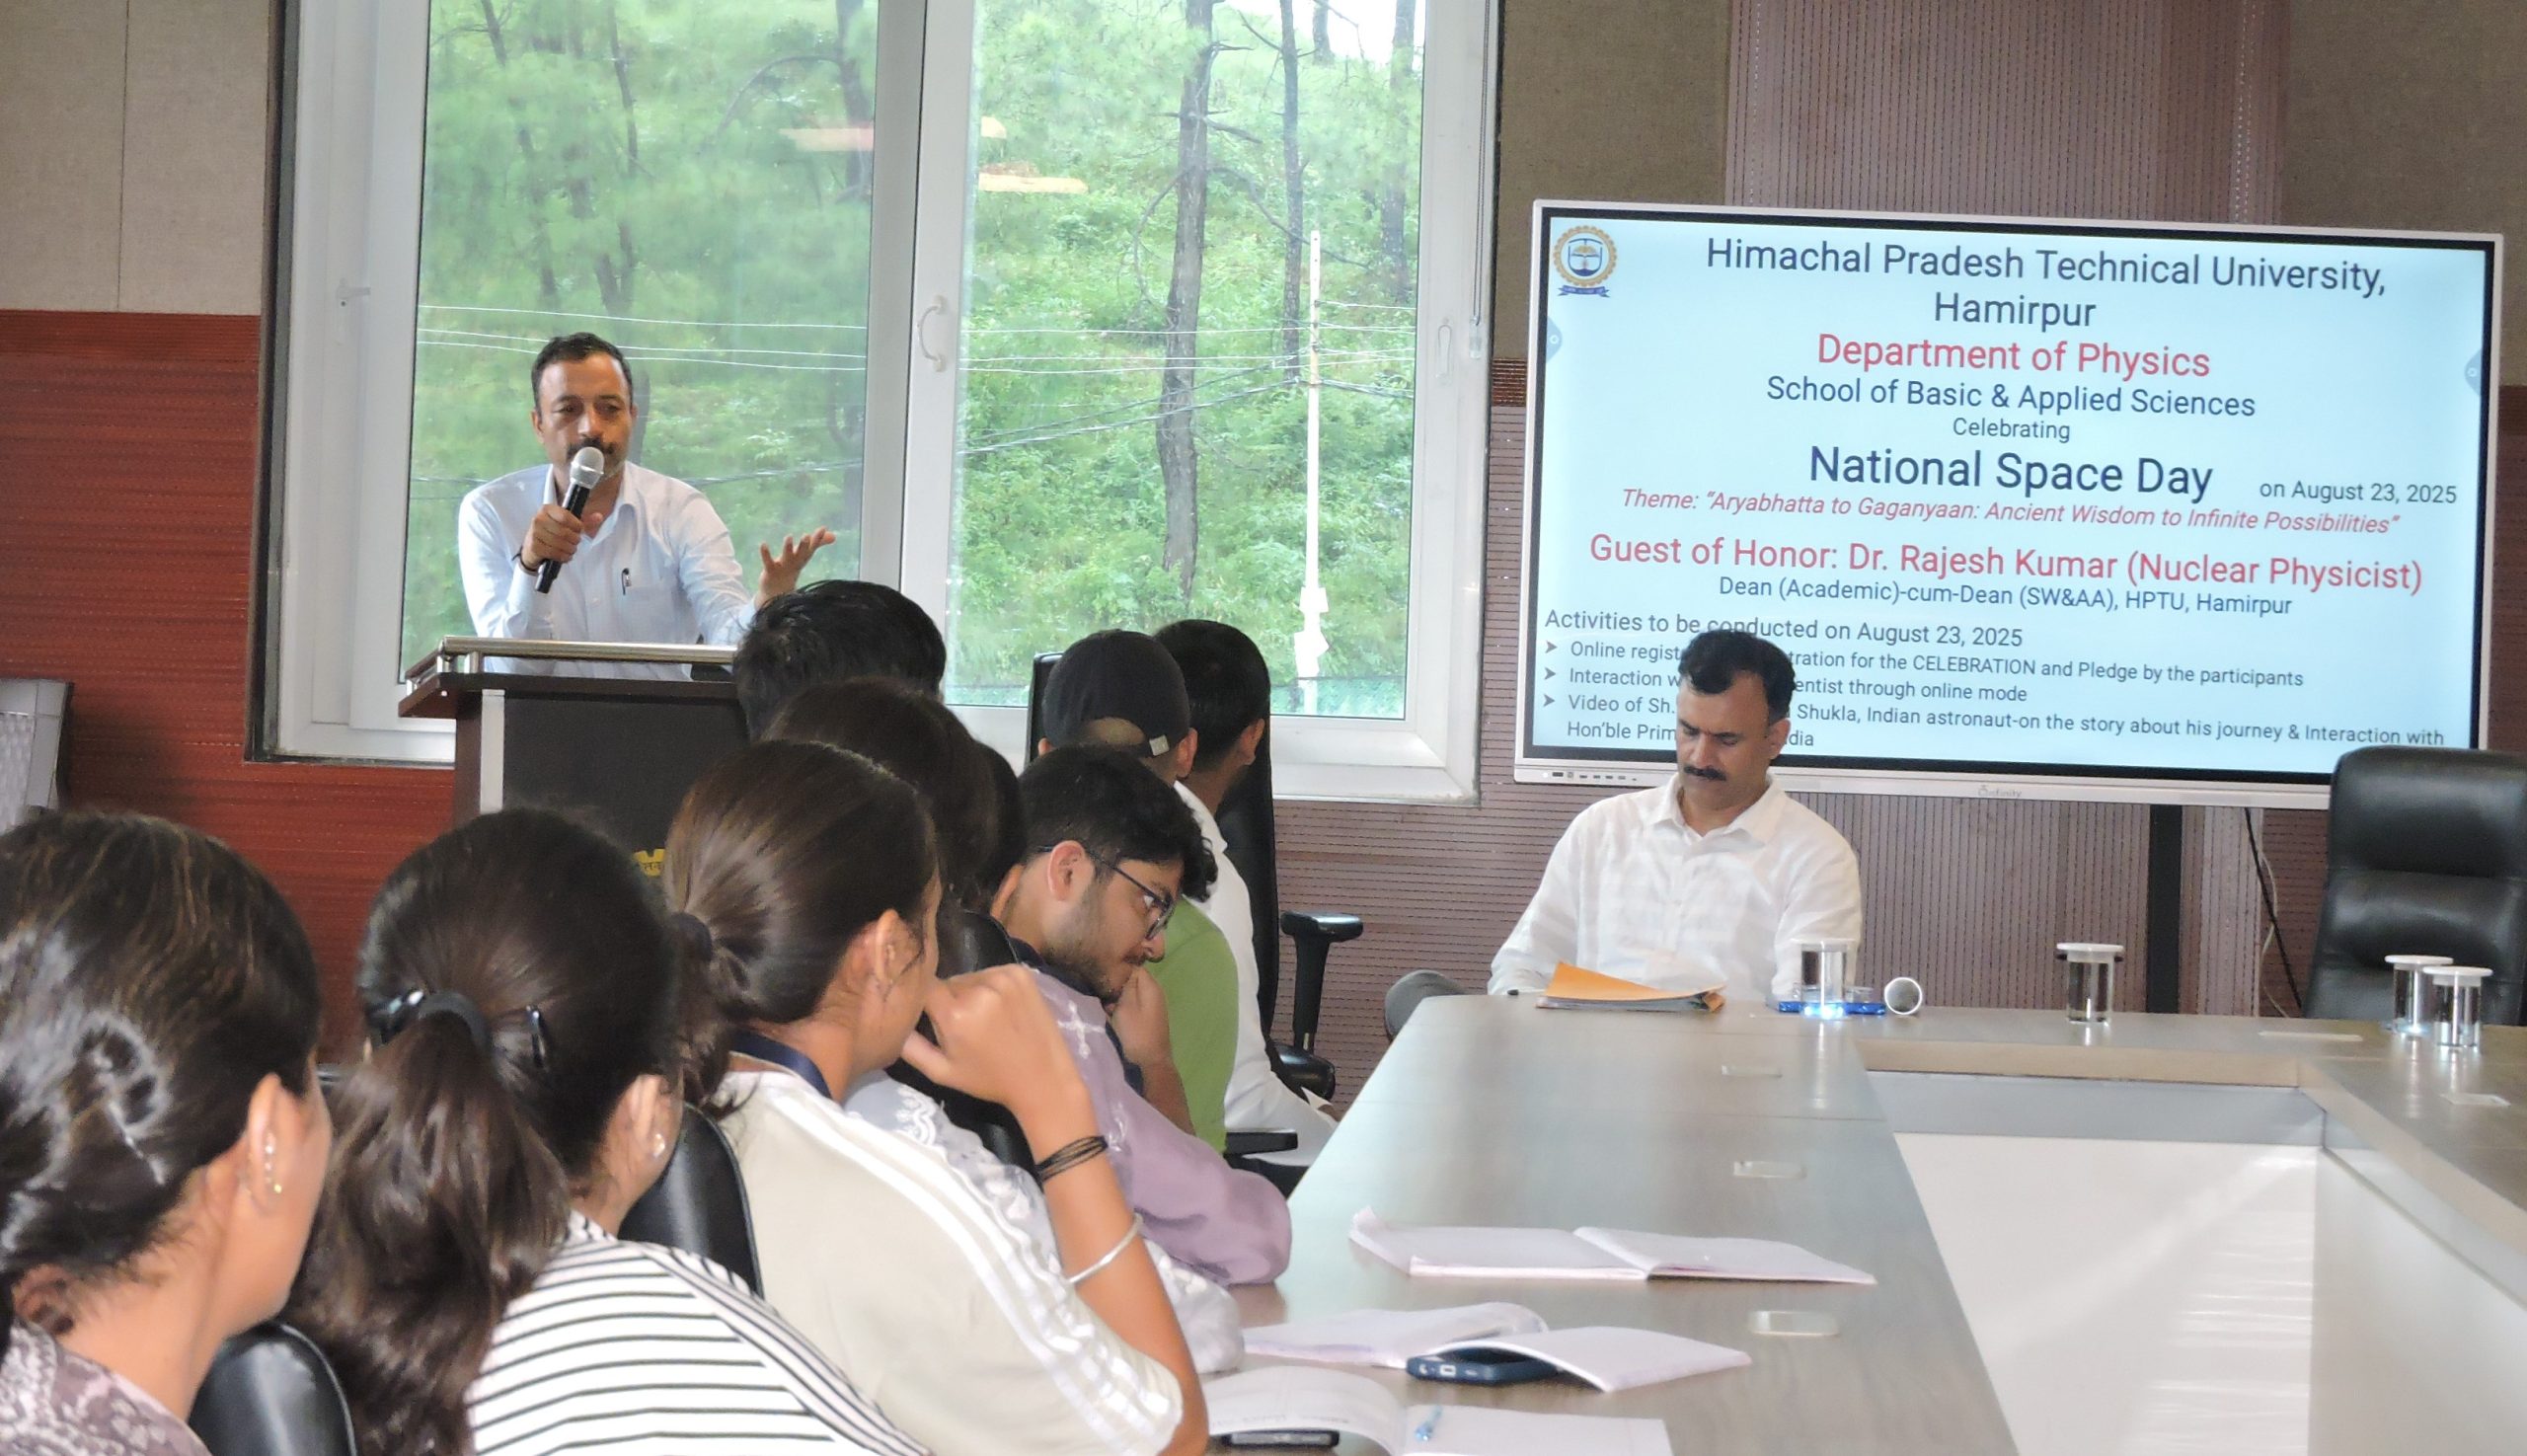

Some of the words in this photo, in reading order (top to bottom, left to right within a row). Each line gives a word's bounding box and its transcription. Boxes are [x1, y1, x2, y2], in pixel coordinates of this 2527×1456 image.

[1708, 238, 1871, 272] Himachal
[1884, 245, 2024, 278] Pradesh
[2035, 250, 2199, 284] Technical
[2213, 256, 2384, 298] University,
[1935, 292, 2097, 333] Hamirpur
[1819, 334, 2020, 372] Department
[2032, 342, 2067, 371] of
[2079, 343, 2209, 381] Physics
[1767, 376, 1861, 402] School
[1871, 379, 1899, 403] of
[1907, 381, 1982, 407] Basic
[1991, 384, 2010, 408] &
[2018, 385, 2121, 416] Applied
[2131, 389, 2255, 417] Sciences
[1953, 418, 2070, 443] Celebrating
[1811, 446, 1981, 487] National
[1996, 452, 2123, 498] Space
[2138, 458, 2213, 504] Day
[2259, 484, 2285, 498] on
[2291, 481, 2363, 503] August
[2371, 483, 2400, 504] 23,
[2407, 485, 2456, 503] 2025
[1624, 489, 1699, 508] Theme:
[1832, 498, 1851, 514] to
[1858, 498, 1980, 521] Gaganyaan:
[1984, 502, 2064, 521] Ancient
[2073, 505, 2155, 524] Wisdom
[2162, 510, 2182, 525] to
[2187, 508, 2258, 528] Infinite
[1591, 534, 1681, 563] Guest
[1692, 537, 1724, 565] of
[1735, 539, 1837, 569] Honor:
[1850, 543, 1887, 571] Dr.
[1902, 545, 2003, 579] Rajesh
[2017, 549, 2117, 577] Kumar
[2128, 551, 2259, 586] (Nuclear
[2270, 558, 2420, 595] Physicist)
[1720, 576, 1772, 595] Dean
[1780, 576, 2013, 605] (Academic)-cum-Dean
[2020, 585, 2118, 612] (SW&AA),
[2126, 591, 2188, 613] HPTU,
[2197, 593, 2292, 618] Hamirpur
[1545, 609, 1642, 631] Activities
[1648, 615, 1668, 632] to
[1677, 614, 1700, 633] be
[1825, 626, 1850, 640] on
[1857, 623, 1929, 646] August
[1937, 626, 1964, 647] 23,
[1972, 627, 2022, 647] 2025
[1570, 668, 1661, 686] Interaction
[1795, 678, 1843, 695] entist
[1849, 679, 1915, 700] through
[1921, 683, 1972, 699] online
[1979, 686, 2027, 701] mode
[1571, 642, 1625, 657] Online
[1631, 644, 1681, 663] regist
[1789, 651, 1845, 667] tration
[1851, 651, 1875, 668] for
[1879, 653, 1907, 669] the
[1913, 655, 2035, 674] CELEBRATION
[2041, 661, 2073, 676] and
[2079, 661, 2137, 682] Pledge
[2144, 664, 2163, 684] by
[2168, 665, 2194, 681] the
[2200, 669, 2303, 687] participants
[1569, 695, 1619, 711] Video
[1625, 697, 1643, 712] of
[1648, 698, 1674, 714] Sh.
[1798, 704, 1861, 724] Shukla,
[1868, 707, 1920, 723] Indian
[1927, 712, 2039, 728] astronaut-on
[2046, 714, 2074, 730] the
[2081, 718, 2124, 735] story
[2130, 718, 2180, 734] about
[2186, 720, 2211, 735] his
[2216, 722, 2282, 742] journey
[2288, 725, 2299, 739] &
[2306, 726, 2400, 746] Interaction
[2408, 730, 2443, 744] with
[1638, 724, 1677, 740] Prim
[1785, 729, 1814, 747] dia
